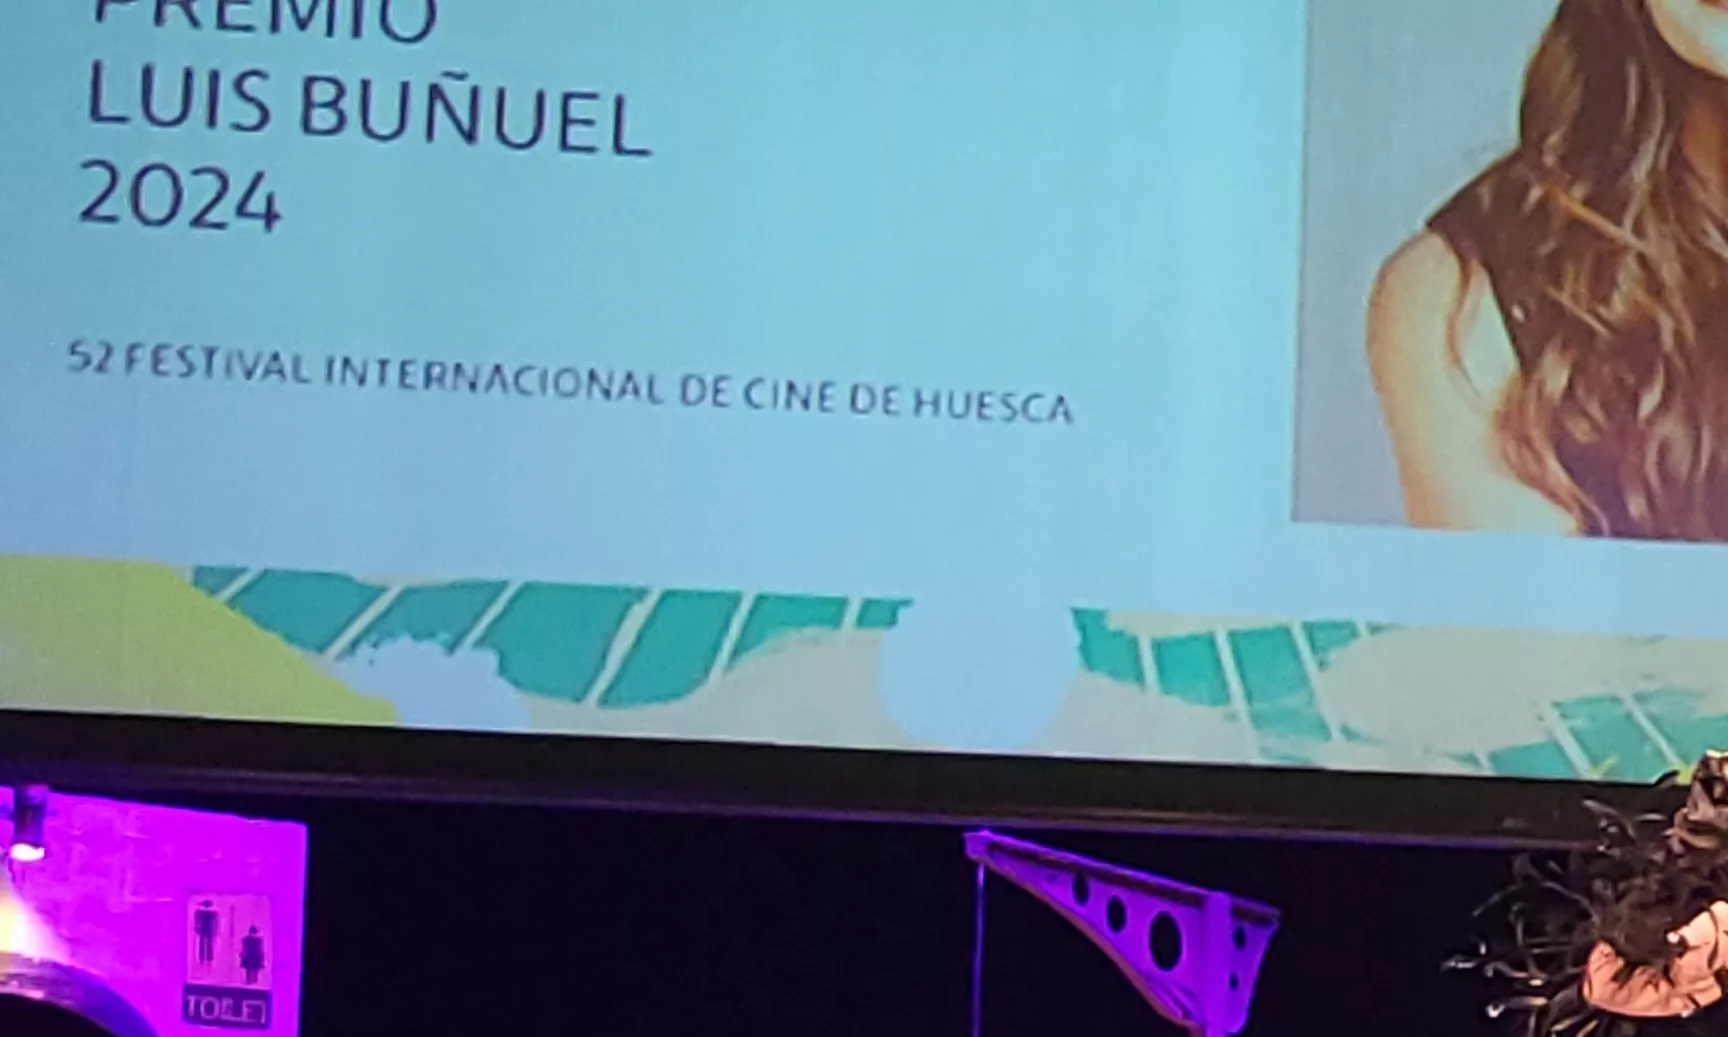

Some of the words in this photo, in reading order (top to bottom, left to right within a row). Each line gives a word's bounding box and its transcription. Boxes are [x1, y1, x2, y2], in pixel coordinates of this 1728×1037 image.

[87, 58, 273, 133] LUIS
[299, 69, 655, 159] BUÑUEL
[78, 157, 284, 235] 2024
[67, 338, 114, 375] 52
[124, 341, 312, 385] FESTIVAL
[324, 354, 665, 406] INTERNACIONAL
[679, 372, 732, 408] DE
[742, 375, 838, 414] CINE
[848, 382, 900, 417] DE
[912, 387, 1076, 426] HUESCA
[186, 994, 267, 1024] TOILET
